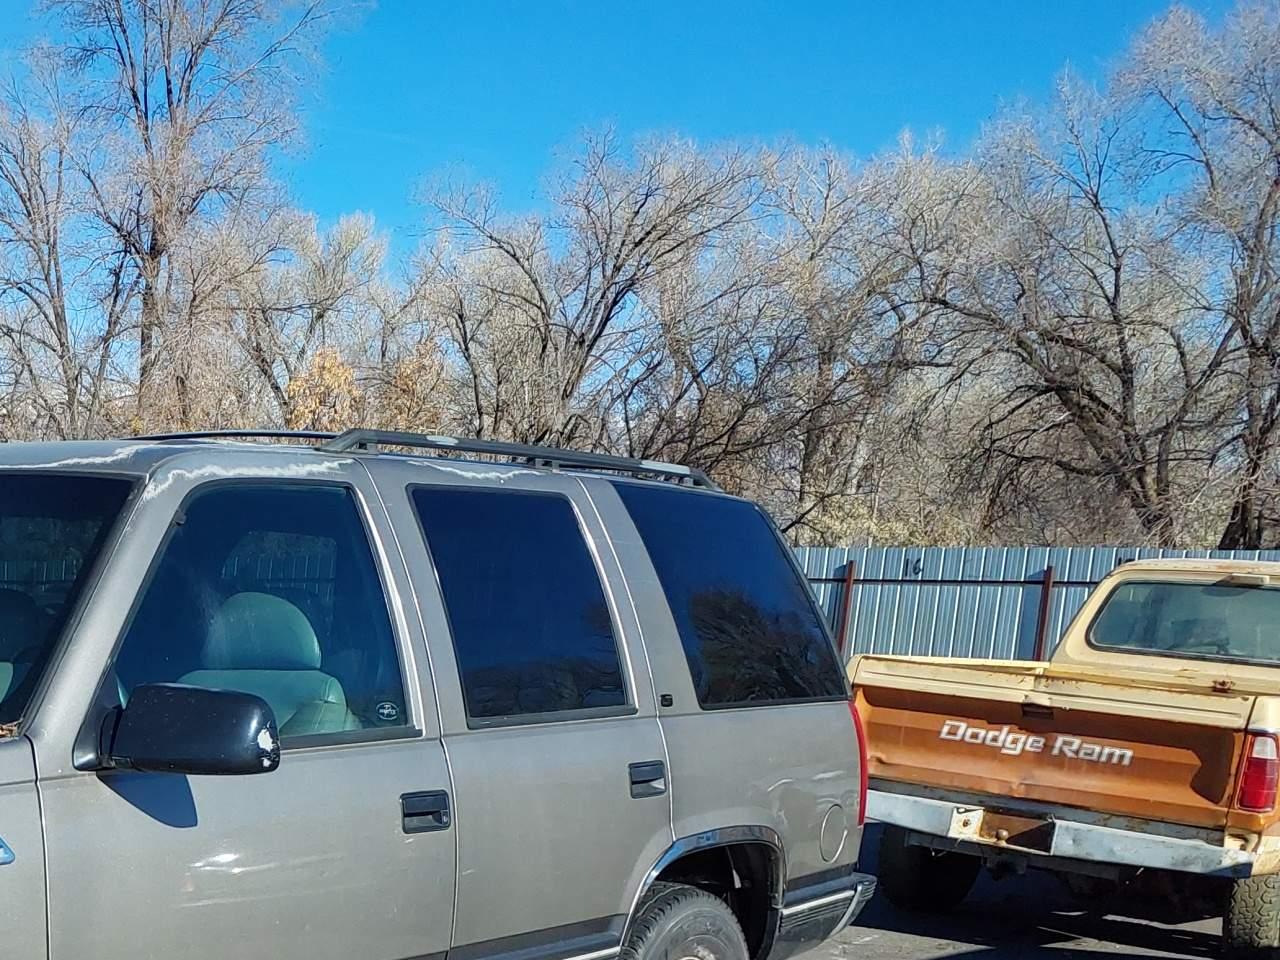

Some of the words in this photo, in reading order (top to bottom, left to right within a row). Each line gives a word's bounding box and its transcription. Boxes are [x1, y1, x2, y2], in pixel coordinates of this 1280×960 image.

[905, 558, 924, 577] 16
[939, 719, 1047, 756] Dodge
[1051, 735, 1134, 766] Ram
